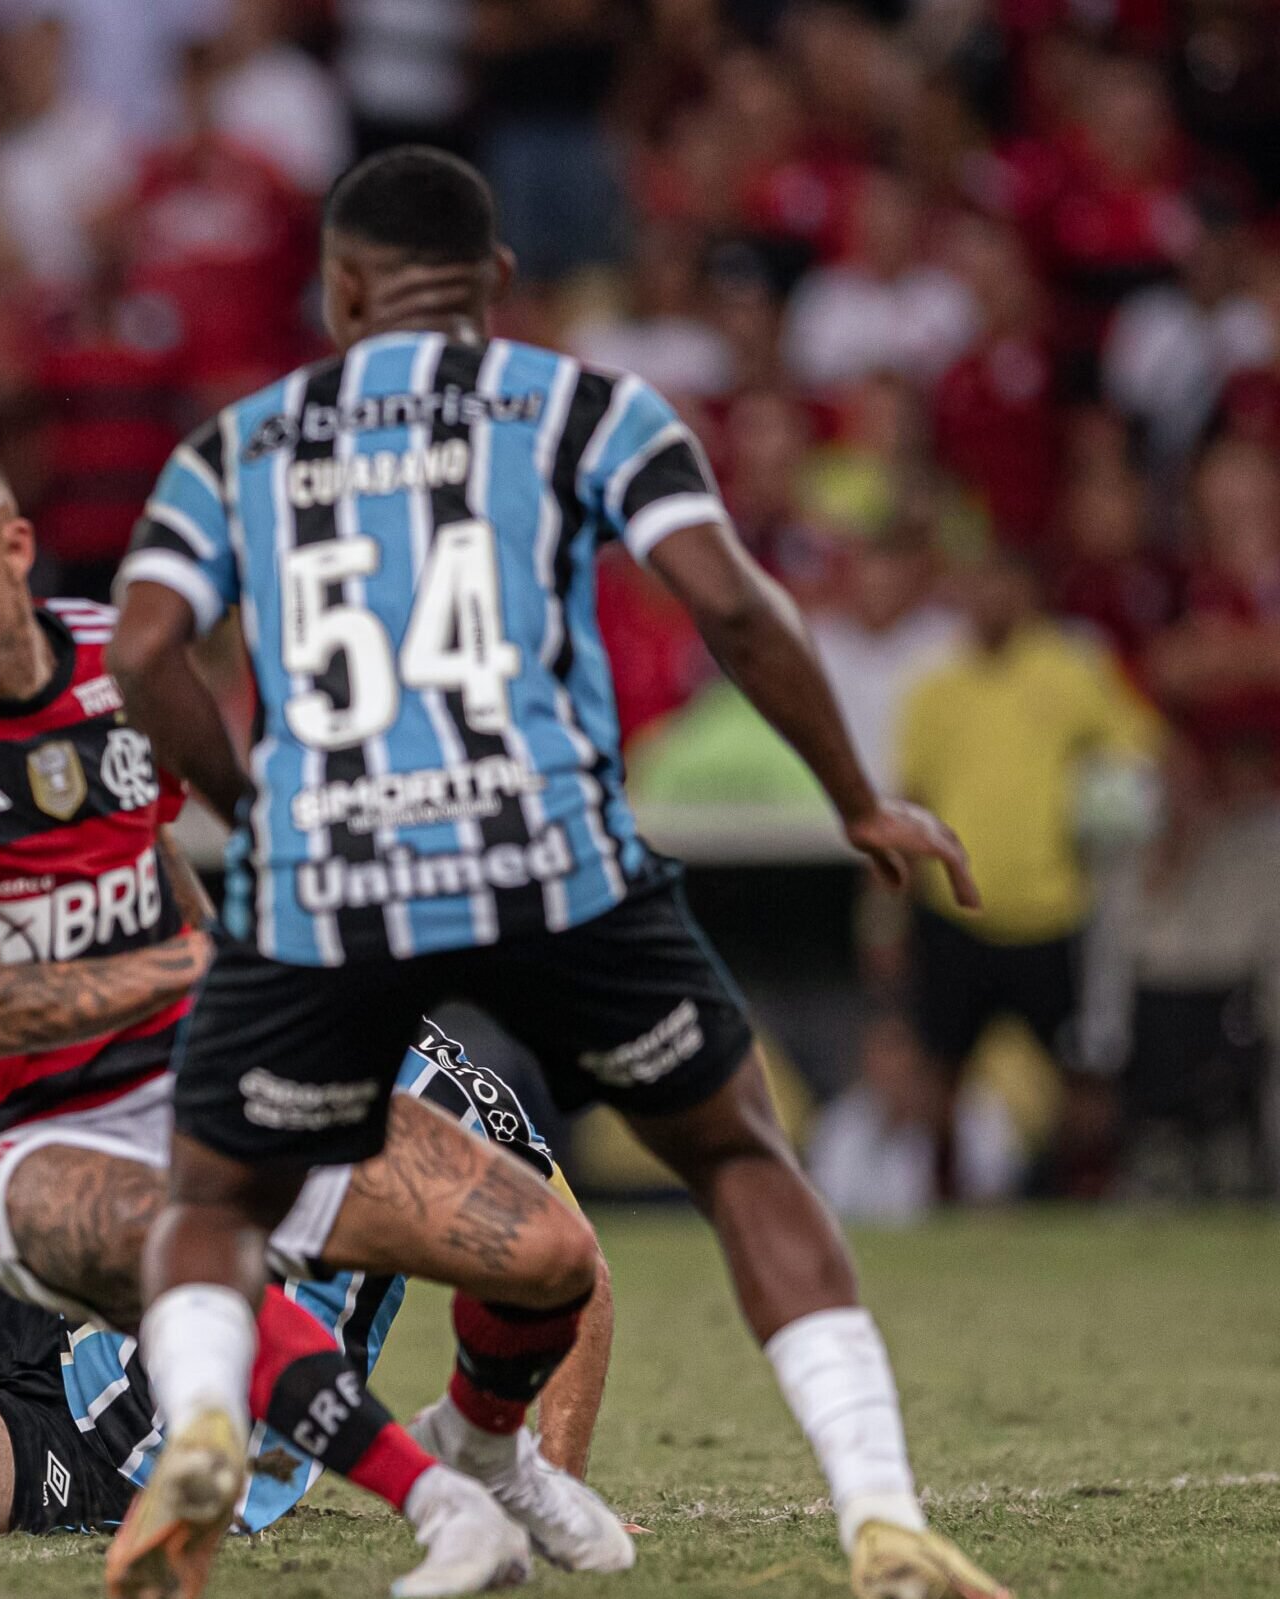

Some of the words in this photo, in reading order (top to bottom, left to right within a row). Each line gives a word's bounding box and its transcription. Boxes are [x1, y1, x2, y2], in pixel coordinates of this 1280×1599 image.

[283, 514, 523, 751] 54
[296, 818, 574, 914] Unimed
[294, 1370, 362, 1455] CRF
